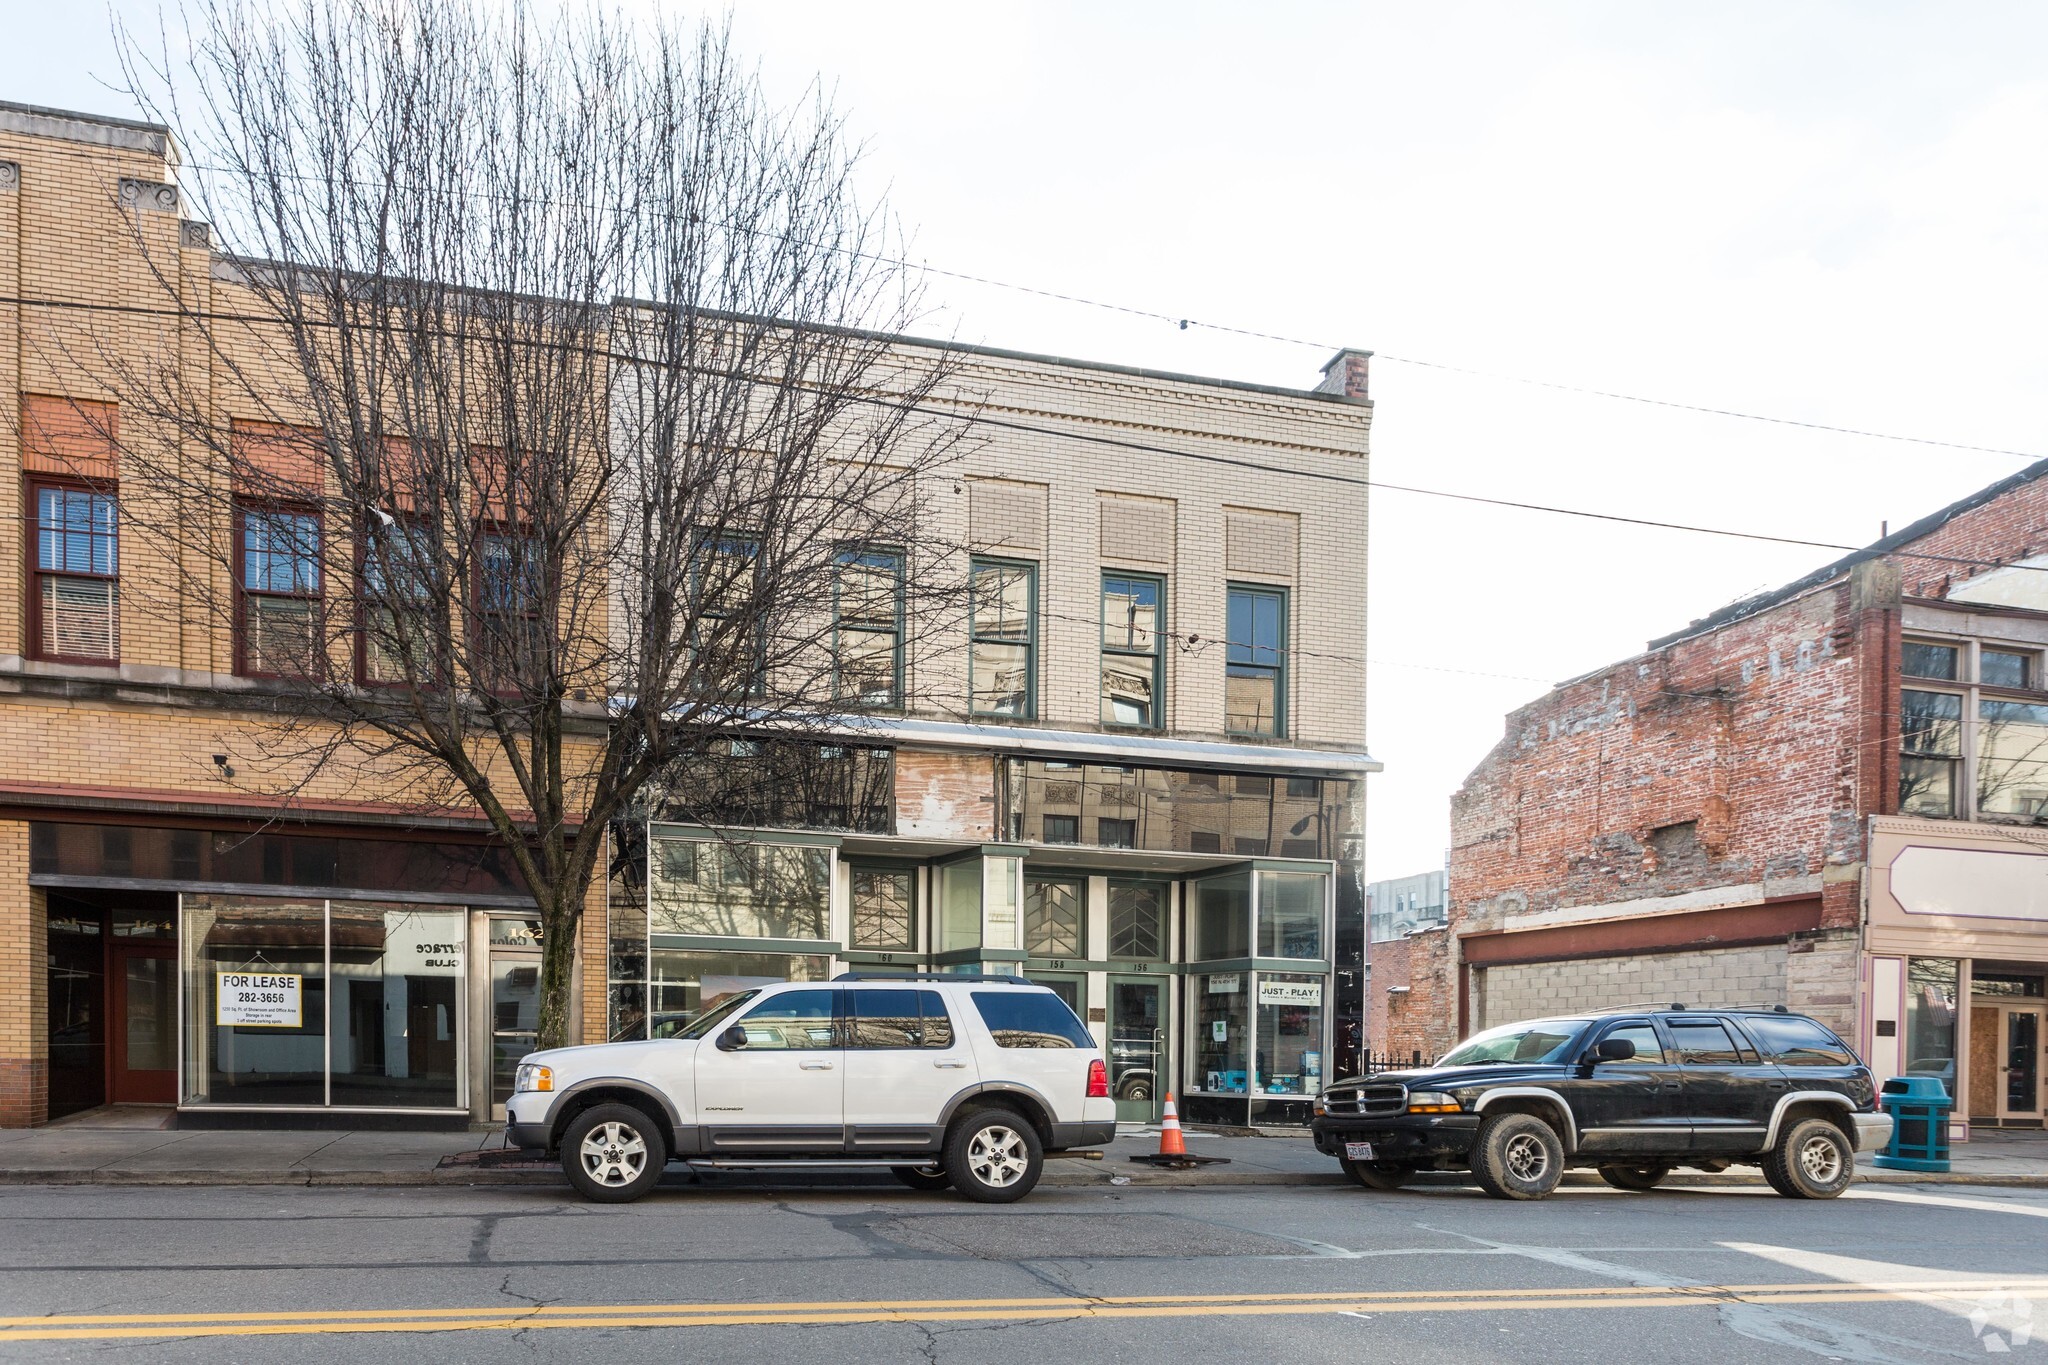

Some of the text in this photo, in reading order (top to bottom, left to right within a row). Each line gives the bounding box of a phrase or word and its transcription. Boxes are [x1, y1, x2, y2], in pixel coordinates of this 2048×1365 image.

[134, 919, 173, 930] 164
[508, 927, 544, 939] 162
[1050, 960, 1065, 969] 158
[1133, 963, 1148, 972] 156
[223, 975, 295, 989] FOR LEASE
[238, 992, 285, 1003] 282-3656
[1261, 987, 1284, 995] JUST
[1290, 988, 1315, 997] PLAY
